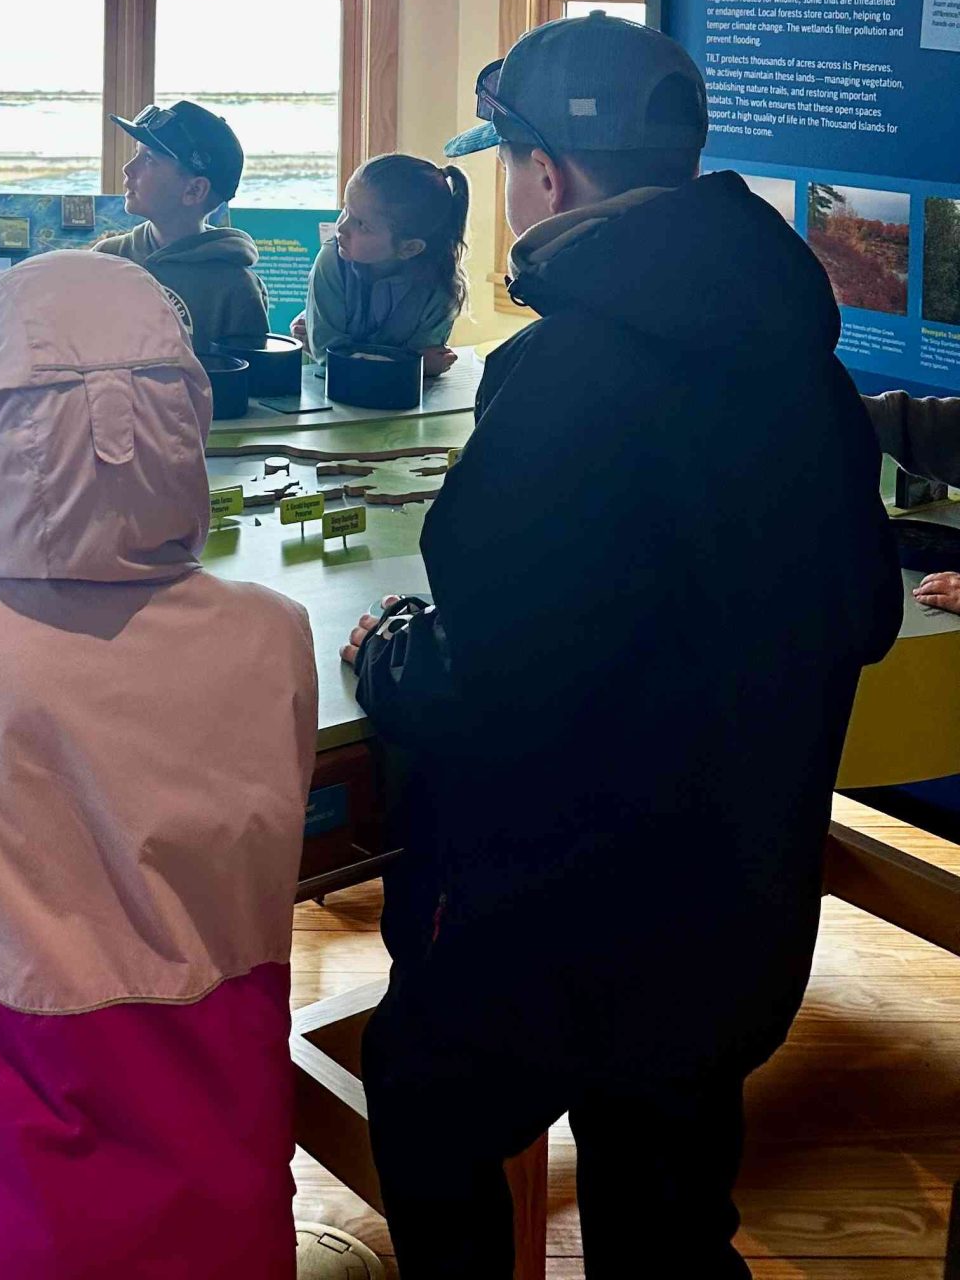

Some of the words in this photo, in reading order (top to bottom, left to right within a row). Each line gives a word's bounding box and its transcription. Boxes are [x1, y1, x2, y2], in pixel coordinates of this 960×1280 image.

[715, 8, 756, 18] endangered.
[758, 8, 776, 17] Local
[778, 8, 802, 18] forests
[804, 10, 822, 19] store
[824, 11, 851, 20] carbon,
[853, 11, 881, 22] helping
[883, 12, 890, 20] to
[706, 21, 730, 30] temper
[732, 21, 756, 30] climate
[758, 22, 785, 33] change.
[787, 22, 800, 32] The
[801, 24, 833, 33] wetlands
[854, 26, 887, 36] pollution
[889, 27, 904, 36] and
[706, 35, 731, 44] prevent
[706, 53, 720, 63] TILT
[721, 55, 748, 64] protects
[750, 56, 786, 66] thousands
[787, 58, 795, 66] of
[796, 60, 815, 68] acres
[817, 61, 841, 70] across
[842, 61, 852, 70] its
[853, 61, 893, 73] Preserves.
[706, 67, 716, 76] We
[717, 68, 742, 79] actively
[744, 70, 774, 80] maintain
[775, 71, 794, 80] these
[862, 79, 904, 89] vegetation,
[705, 82, 745, 93] establishing
[746, 85, 768, 93] nature
[770, 85, 789, 96] trails,
[791, 88, 805, 96] and
[806, 89, 838, 100] restoring
[840, 91, 876, 102] important
[736, 97, 749, 106] This
[751, 99, 767, 107] work
[768, 101, 796, 110] ensures
[797, 102, 812, 112] that
[813, 103, 833, 113] these
[835, 107, 853, 115] open
[855, 108, 881, 117] spaces
[708, 111, 731, 119] upport
[737, 111, 752, 122] high
[753, 113, 776, 124] quality
[778, 115, 785, 123] of
[786, 115, 797, 124] life
[799, 116, 806, 125] in
[807, 117, 819, 126] the
[821, 117, 857, 129] Thousand
[859, 121, 885, 132] Islands
[887, 123, 898, 133] for
[745, 126, 752, 134] to
